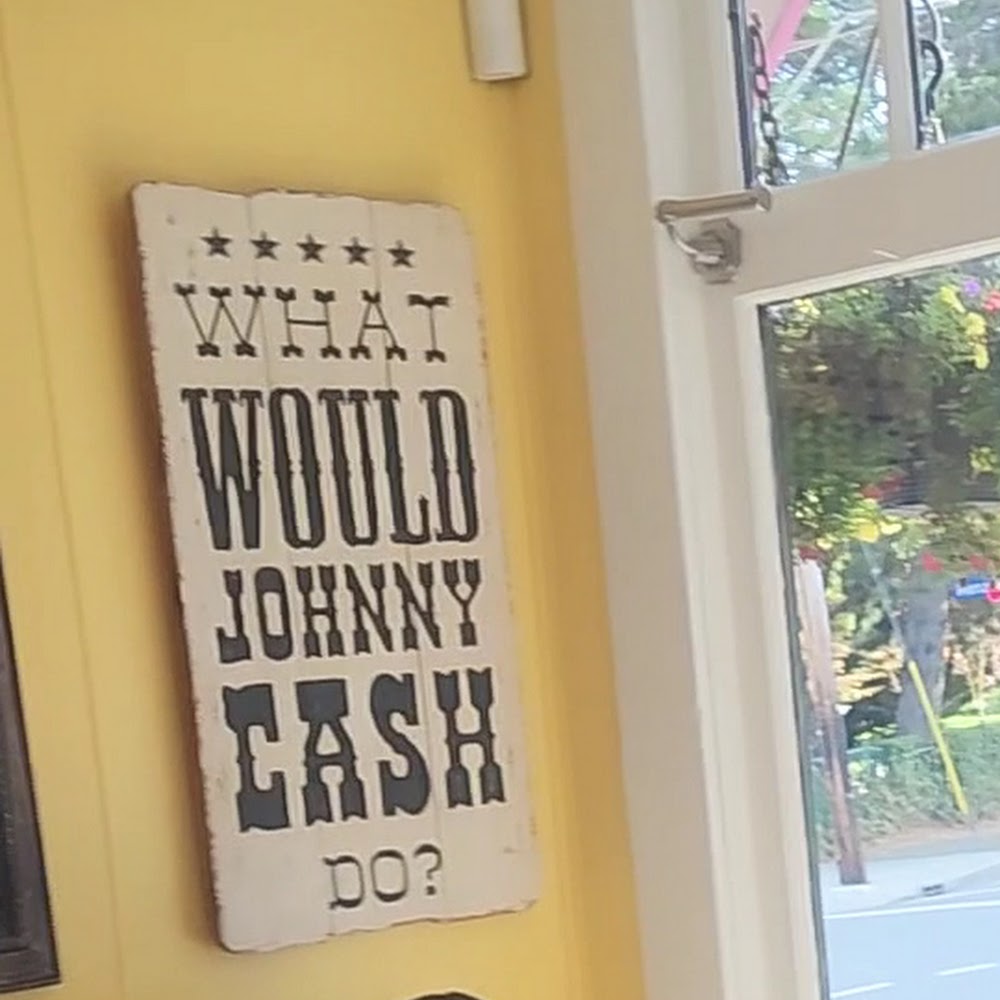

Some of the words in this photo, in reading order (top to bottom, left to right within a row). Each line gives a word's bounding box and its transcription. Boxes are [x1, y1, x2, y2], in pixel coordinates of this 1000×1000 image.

[173, 282, 450, 364] WHAT
[180, 386, 480, 551] WOULD
[215, 558, 482, 664] JOHNNY
[221, 666, 508, 833] CASH
[322, 843, 444, 910] DO?
